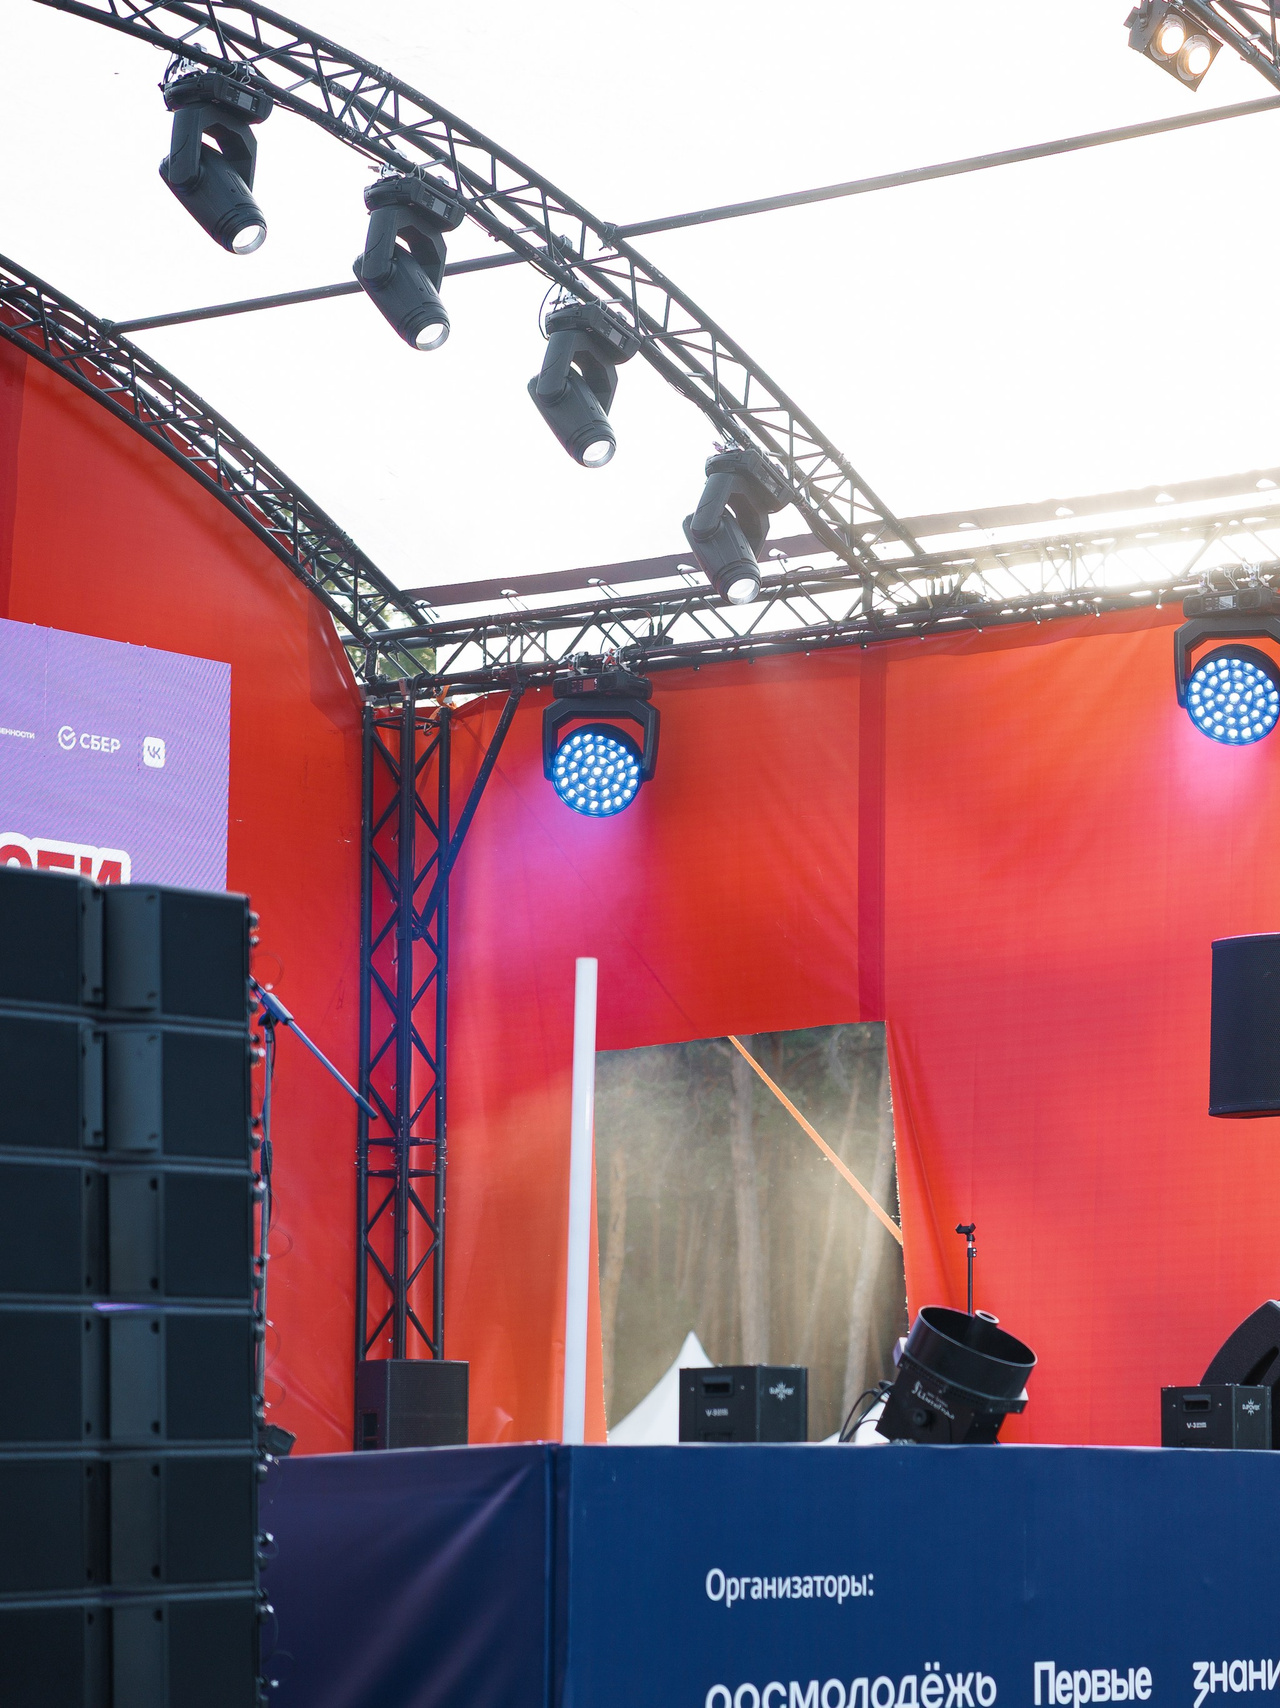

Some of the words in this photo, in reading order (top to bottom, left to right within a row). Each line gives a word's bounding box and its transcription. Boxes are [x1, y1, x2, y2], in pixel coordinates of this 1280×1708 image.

[0, 727, 35, 739] ЕННОСТИ
[79, 732, 121, 753] СБЕР
[706, 1568, 874, 1608] Организаторы:
[1033, 1660, 1153, 1708] Первые
